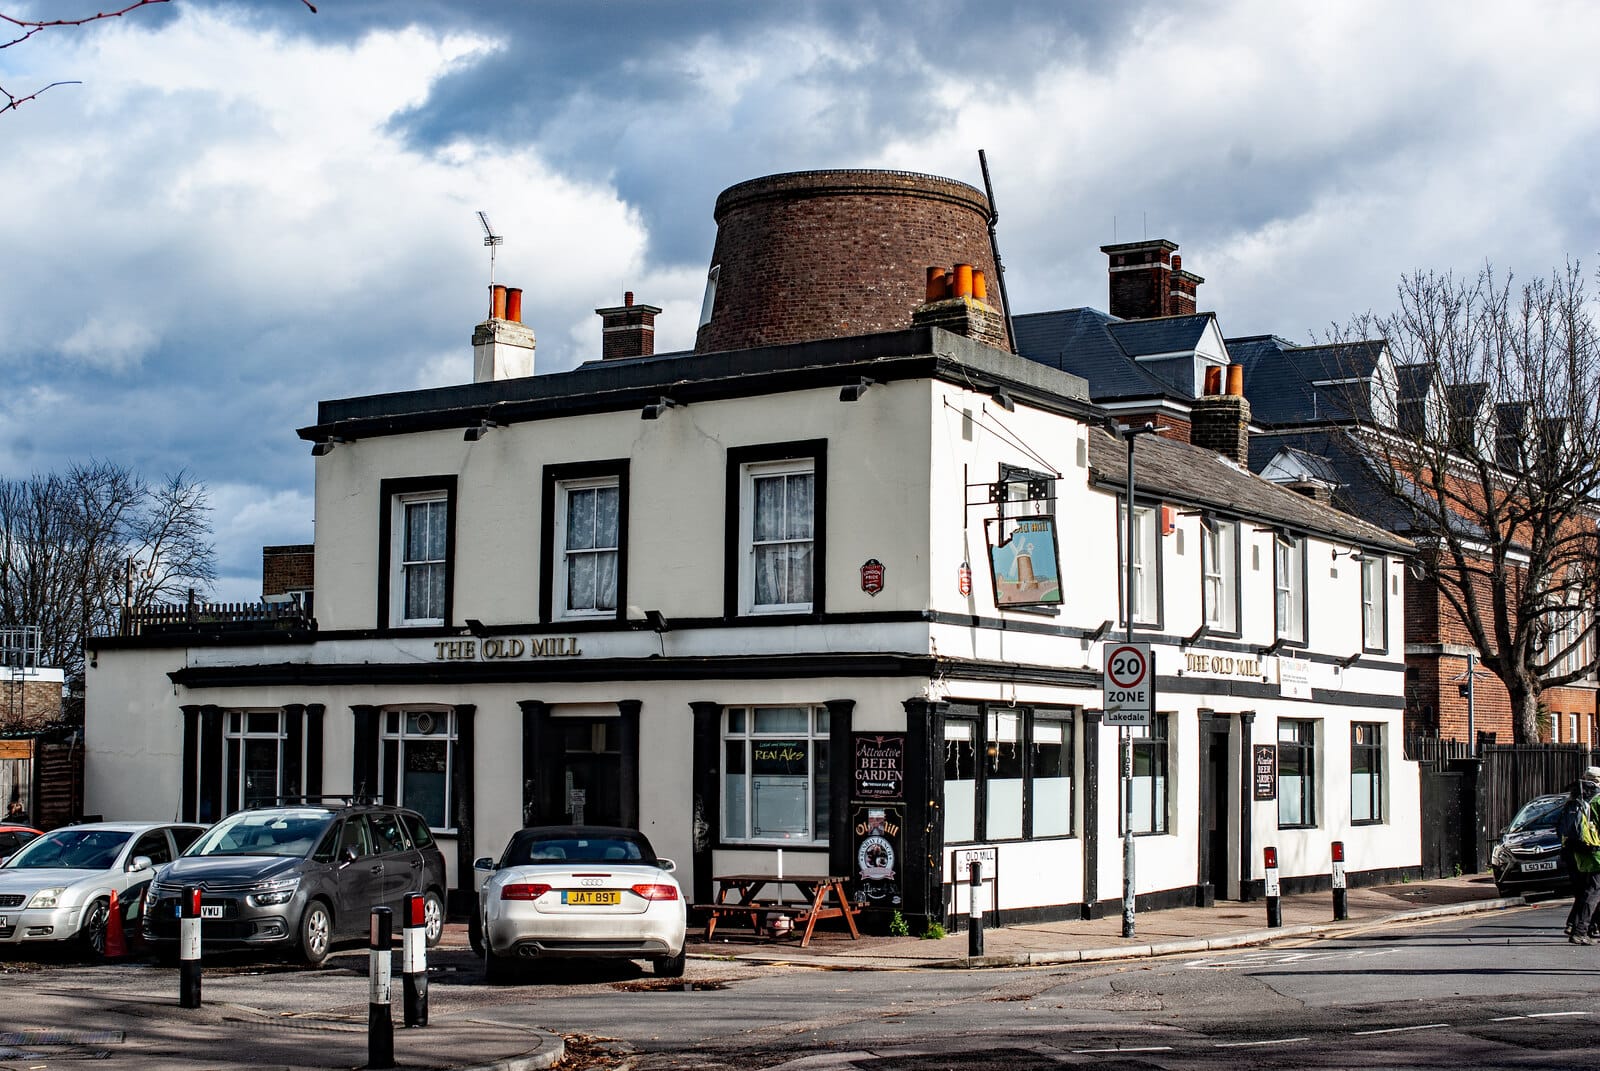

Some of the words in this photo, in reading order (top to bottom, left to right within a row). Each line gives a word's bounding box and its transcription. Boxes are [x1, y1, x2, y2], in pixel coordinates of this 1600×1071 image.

[434, 640, 475, 660] THE
[482, 638, 525, 659] OLD
[531, 637, 582, 657] MILL
[1114, 658, 1140, 675] 20
[1185, 653, 1210, 673] THE
[1211, 656, 1233, 674] OLD
[1236, 659, 1263, 678] MILL
[1108, 691, 1145, 703] ZONE
[1108, 712, 1145, 721] Lakedale
[857, 744, 901, 757] Attractive
[861, 758, 897, 769] BEER
[855, 770, 903, 781] GARDEN
[966, 851, 978, 862] OLD
[980, 850, 994, 861] MILL
[572, 892, 594, 902] JAT
[595, 892, 616, 902] 89T
[202, 907, 219, 916] VWU
